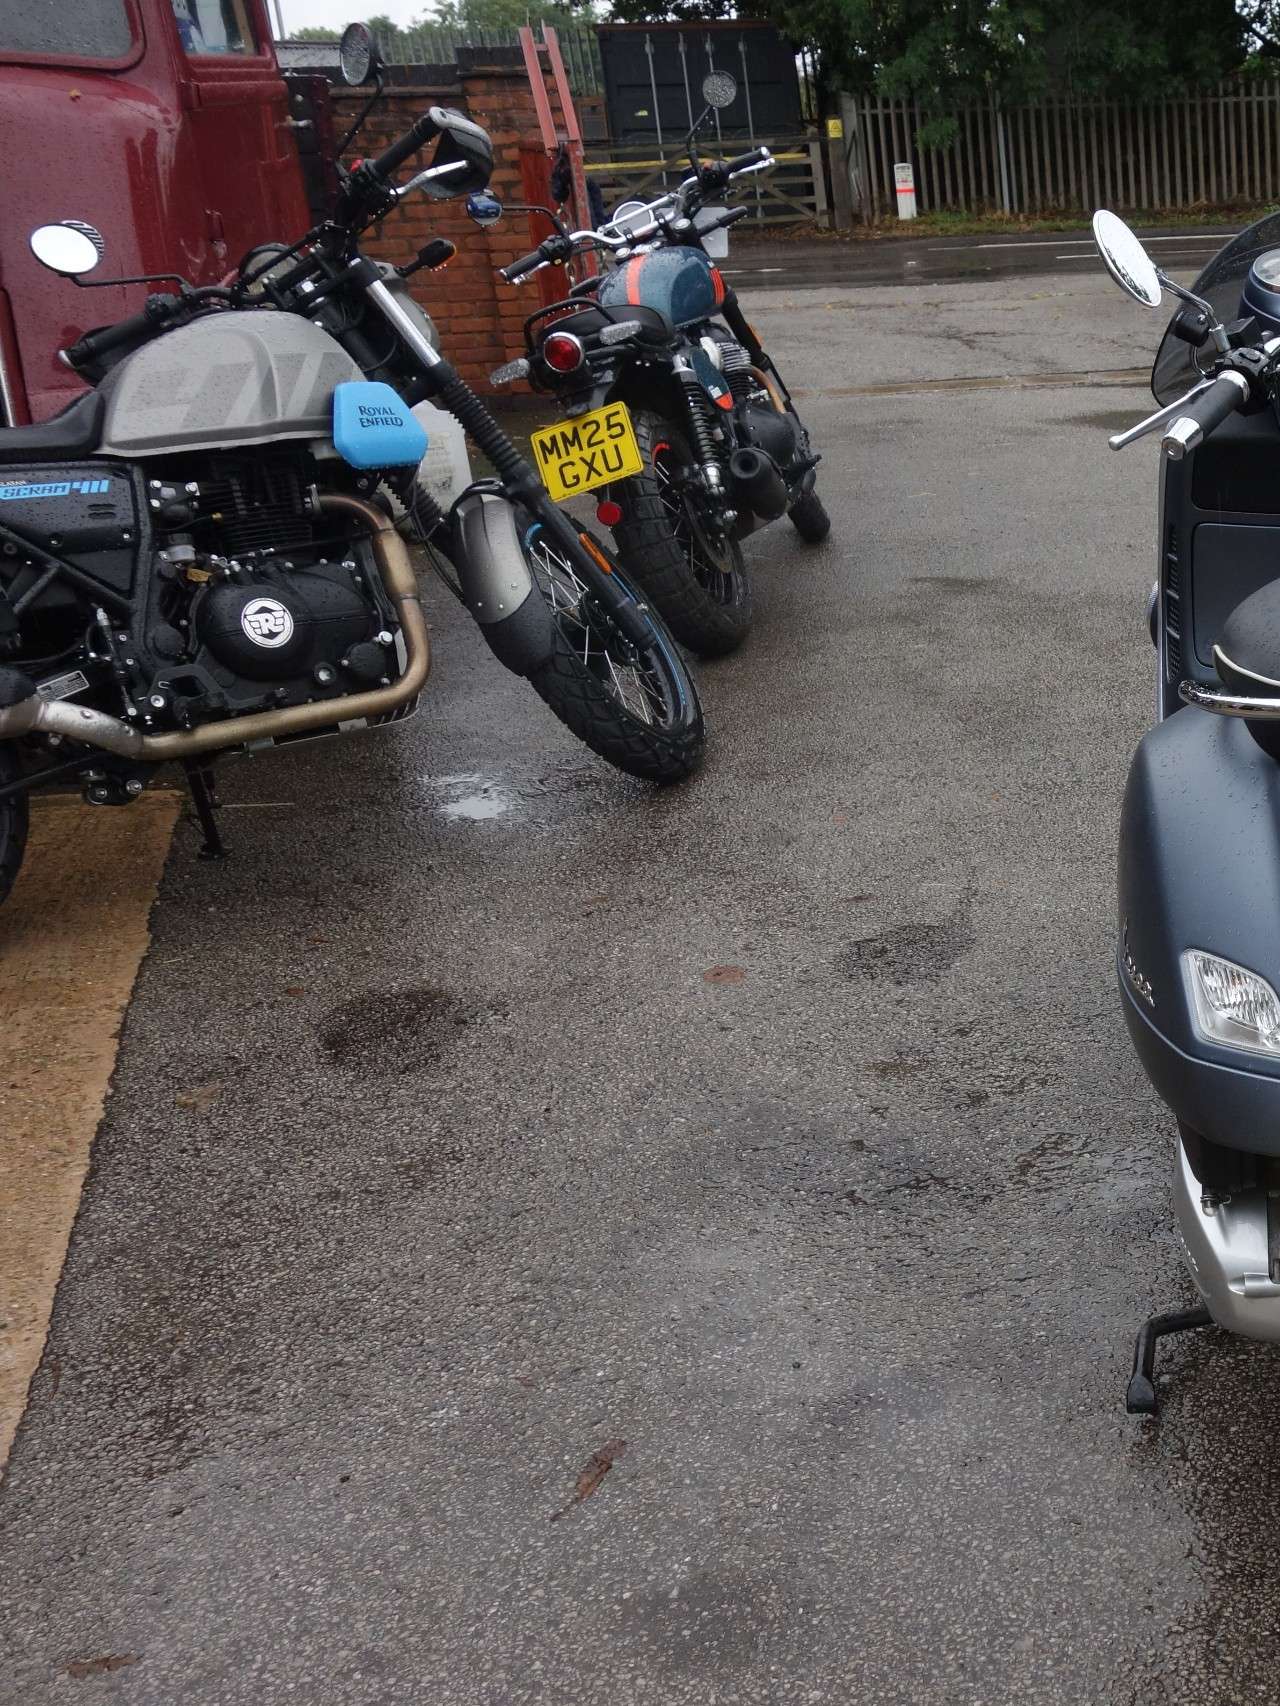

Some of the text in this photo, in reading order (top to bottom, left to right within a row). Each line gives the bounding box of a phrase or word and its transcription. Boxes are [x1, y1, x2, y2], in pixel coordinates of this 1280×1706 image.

[359, 405, 396, 417] ROYAL
[359, 416, 404, 428] ENFIELD
[538, 410, 626, 465] MM25
[558, 444, 624, 489] GXU
